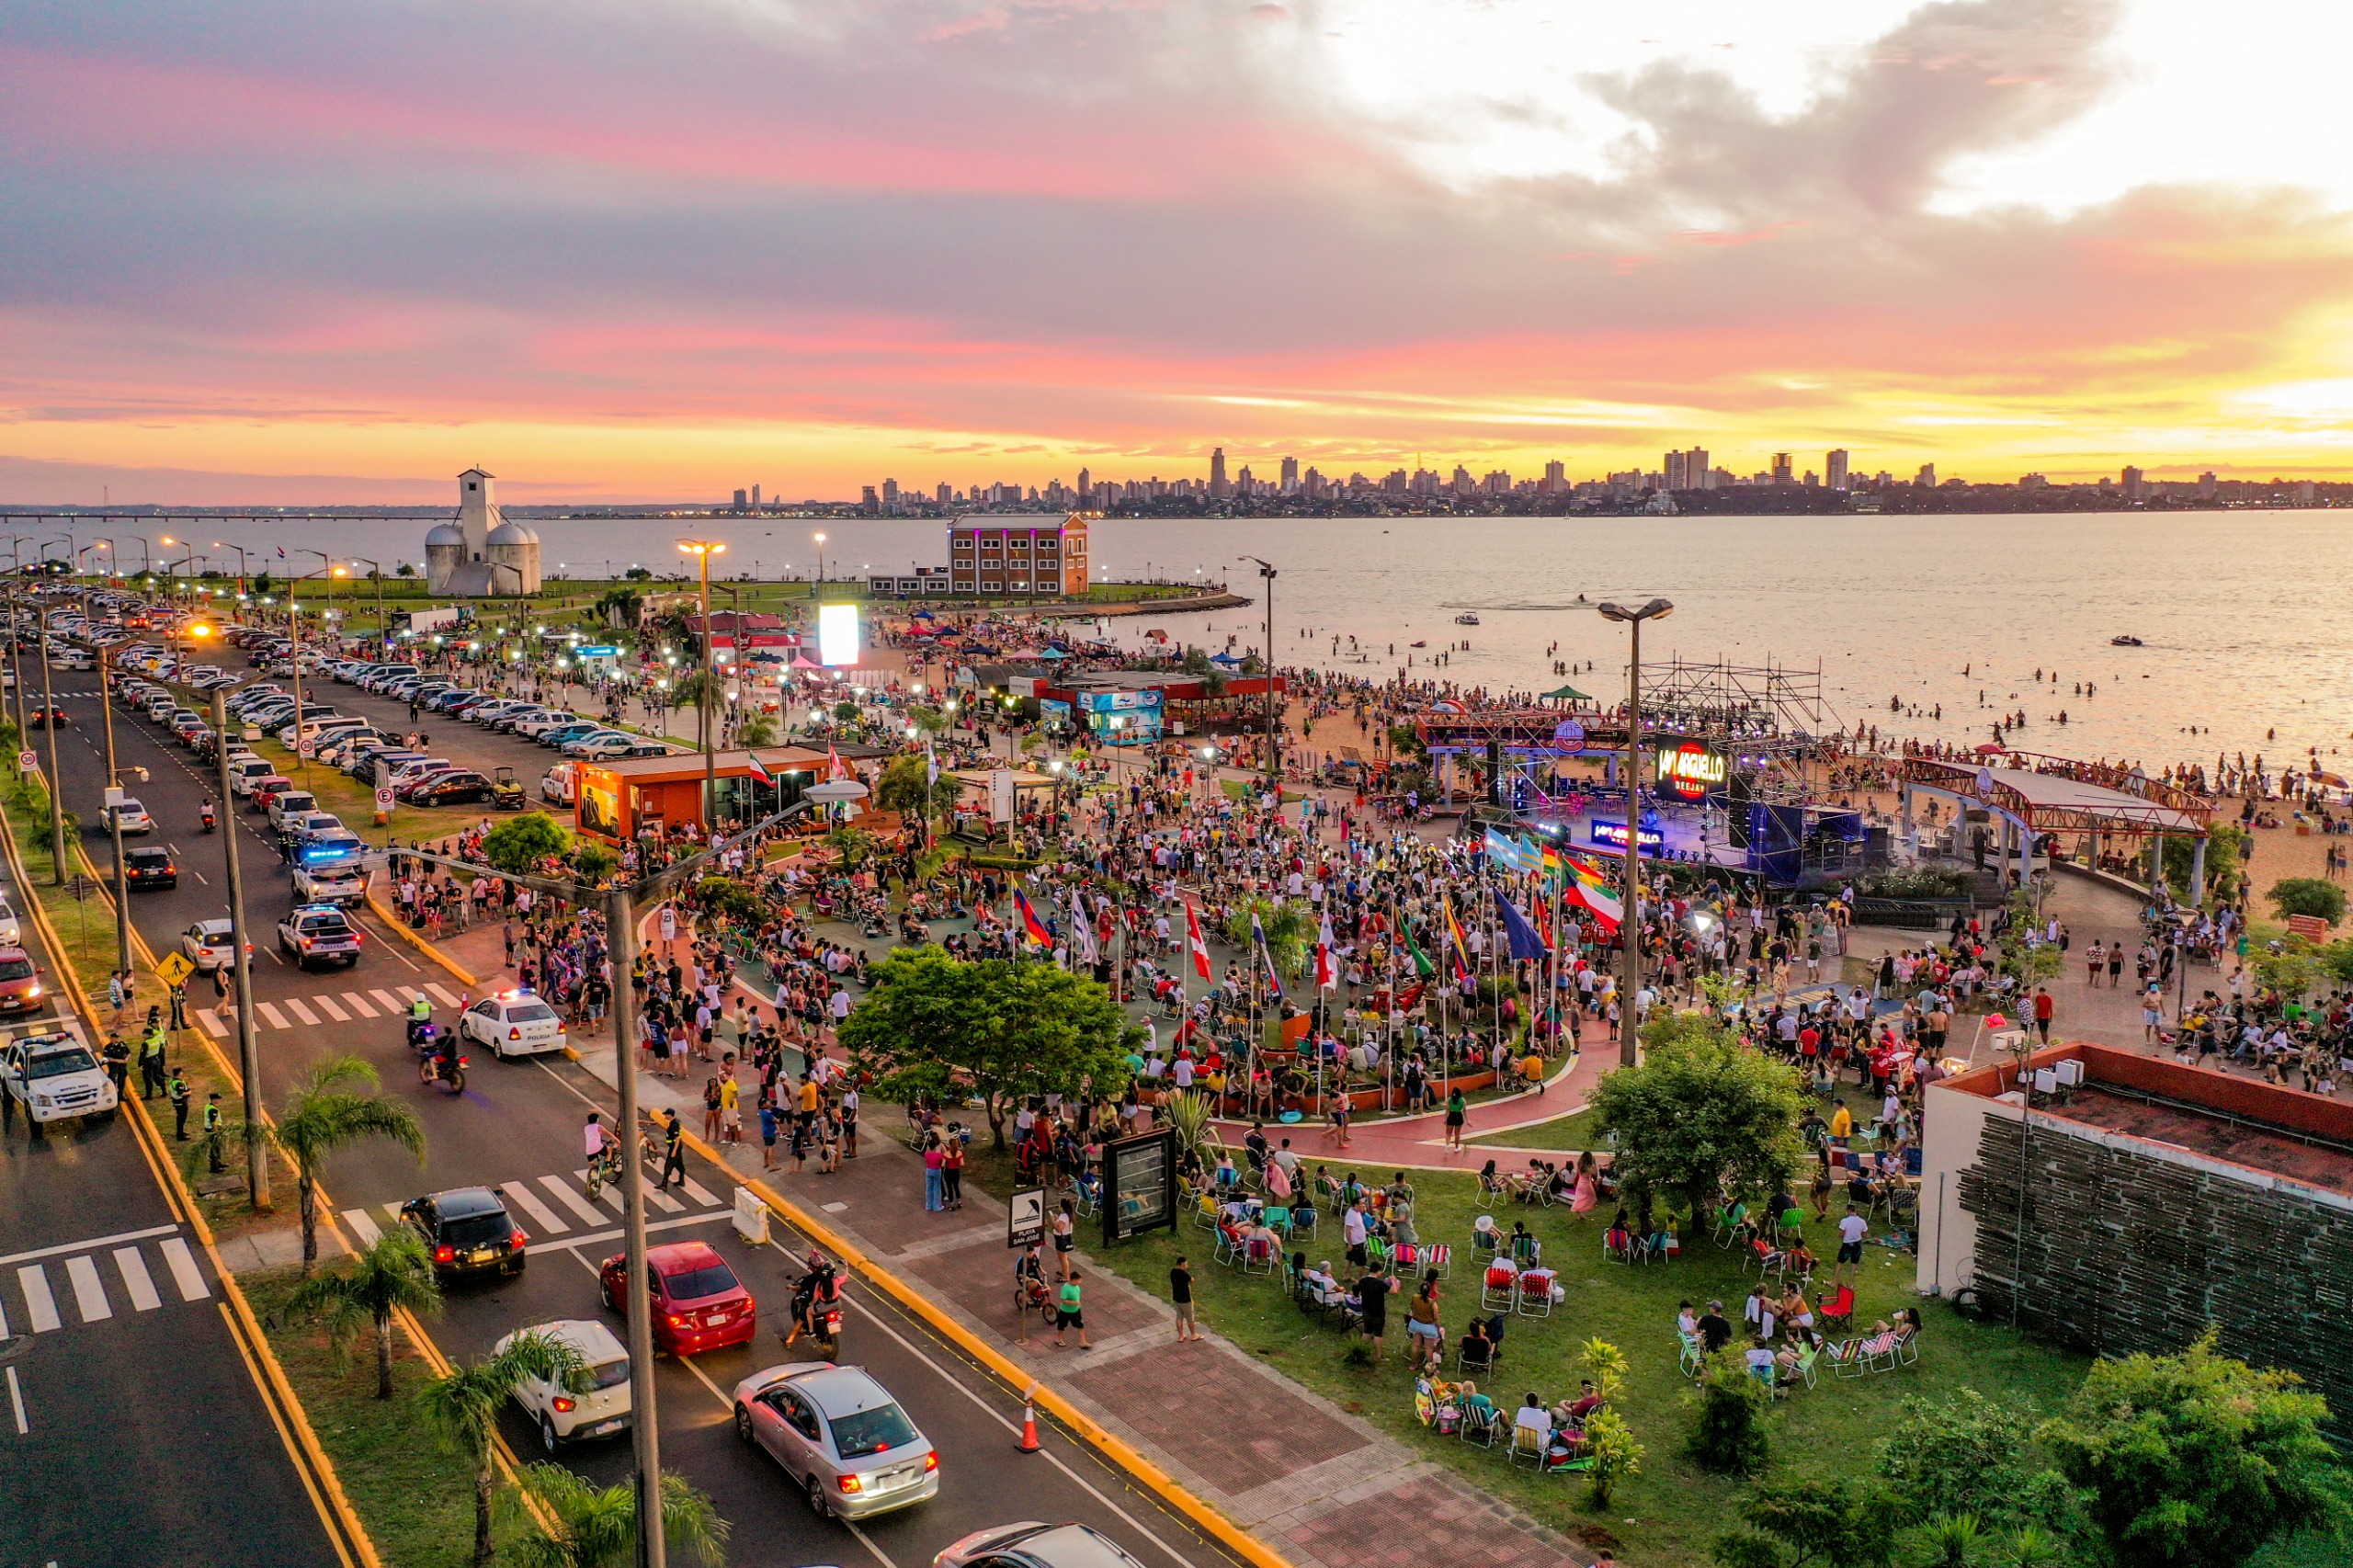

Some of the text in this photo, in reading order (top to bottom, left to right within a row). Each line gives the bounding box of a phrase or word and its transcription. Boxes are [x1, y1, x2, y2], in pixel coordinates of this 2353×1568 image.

[1675, 780, 1705, 792] DEEJAY
[381, 791, 389, 801] E
[663, 915, 672, 923] 23
[1018, 1228, 1036, 1237] PLAYA
[1013, 1237, 1026, 1245] SAN
